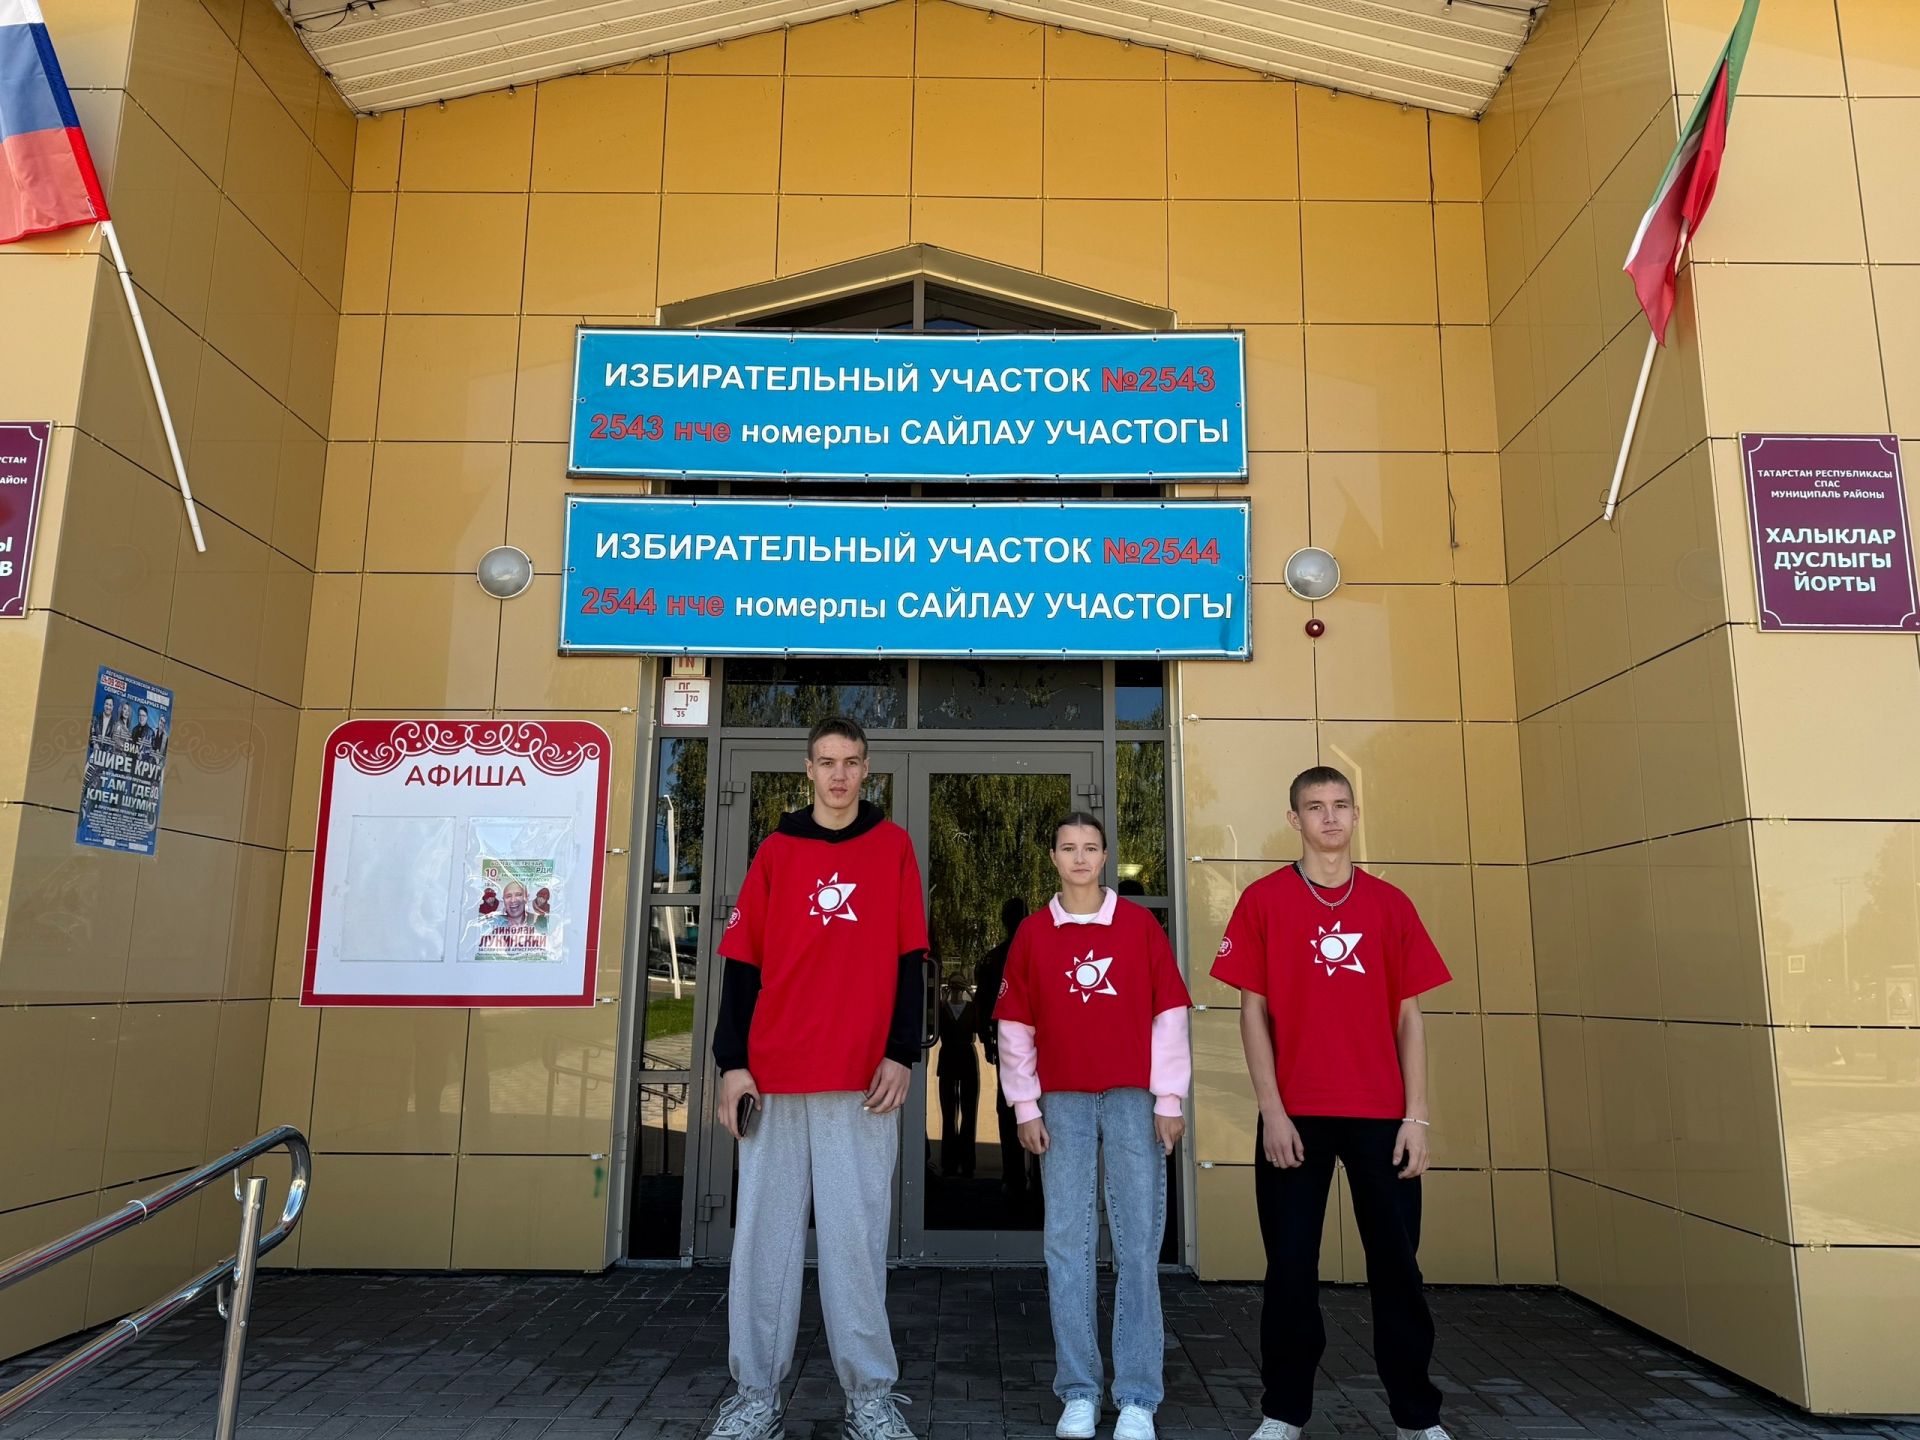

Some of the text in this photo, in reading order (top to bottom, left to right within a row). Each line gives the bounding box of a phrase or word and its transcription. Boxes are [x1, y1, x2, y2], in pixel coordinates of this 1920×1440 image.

[604, 362, 1216, 393] ИЗБИРАТЕЛЬНЫЙ УЧАСТОК №2543
[589, 413, 1229, 449] 2543 нче номерлы САЙЛАУ УЧАСТОГЫ
[0, 456, 27, 464] СТАН
[1757, 469, 1893, 479] ТАТАРСТАН РЕСПУБЛИКАСЫ
[1814, 480, 1840, 488] СПАС
[1771, 489, 1885, 500] МУНИЦИПАЛЬ РАЙОНЫ
[1765, 527, 1896, 545] ХАЛЫКЛАР
[595, 531, 1220, 565] ИЗБИРАТЕЛЬНЫЙ УЧАСТОК №2544
[1774, 551, 1892, 570] ДУСЛЫГЫ
[1793, 571, 1876, 592] ЙОРТЫ
[581, 586, 1232, 624] 2544 нче номерлы САЙЛАУ УЧАСТОГЫ
[678, 682, 691, 690] ПГ
[93, 749, 133, 773] ШИРЕ
[404, 764, 527, 787] АФИША
[86, 787, 158, 813] КЛЕН ШУМИТ
[484, 868, 498, 878] 10
